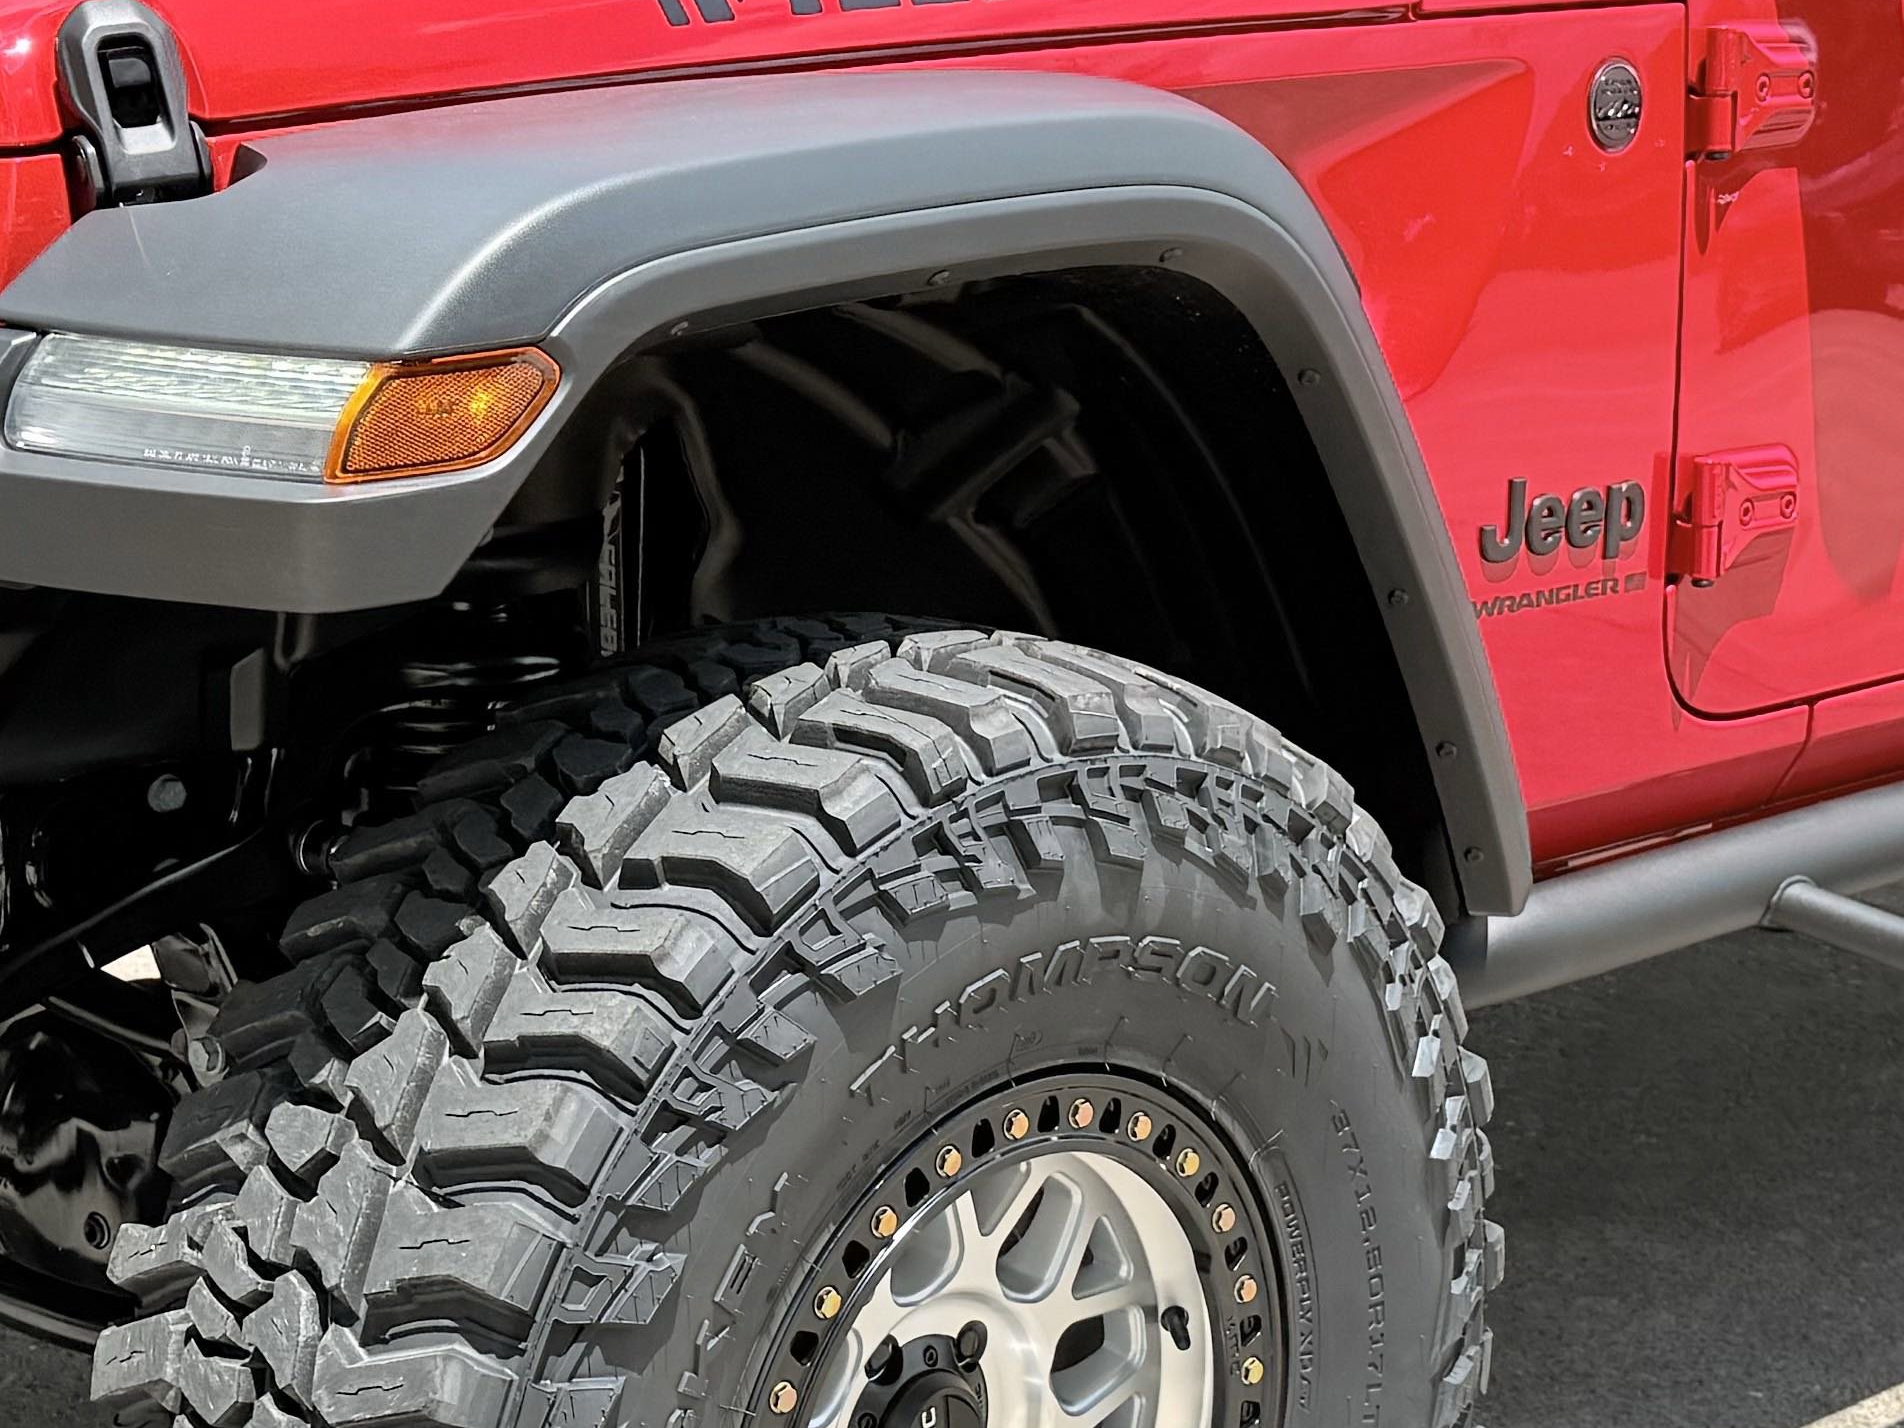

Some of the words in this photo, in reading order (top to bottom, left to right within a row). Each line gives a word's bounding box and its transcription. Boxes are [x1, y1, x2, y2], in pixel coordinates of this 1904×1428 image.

[1478, 476, 1645, 564] Jeep
[1471, 578, 1620, 619] WRANGLER
[849, 934, 1280, 1106] THOMPSON
